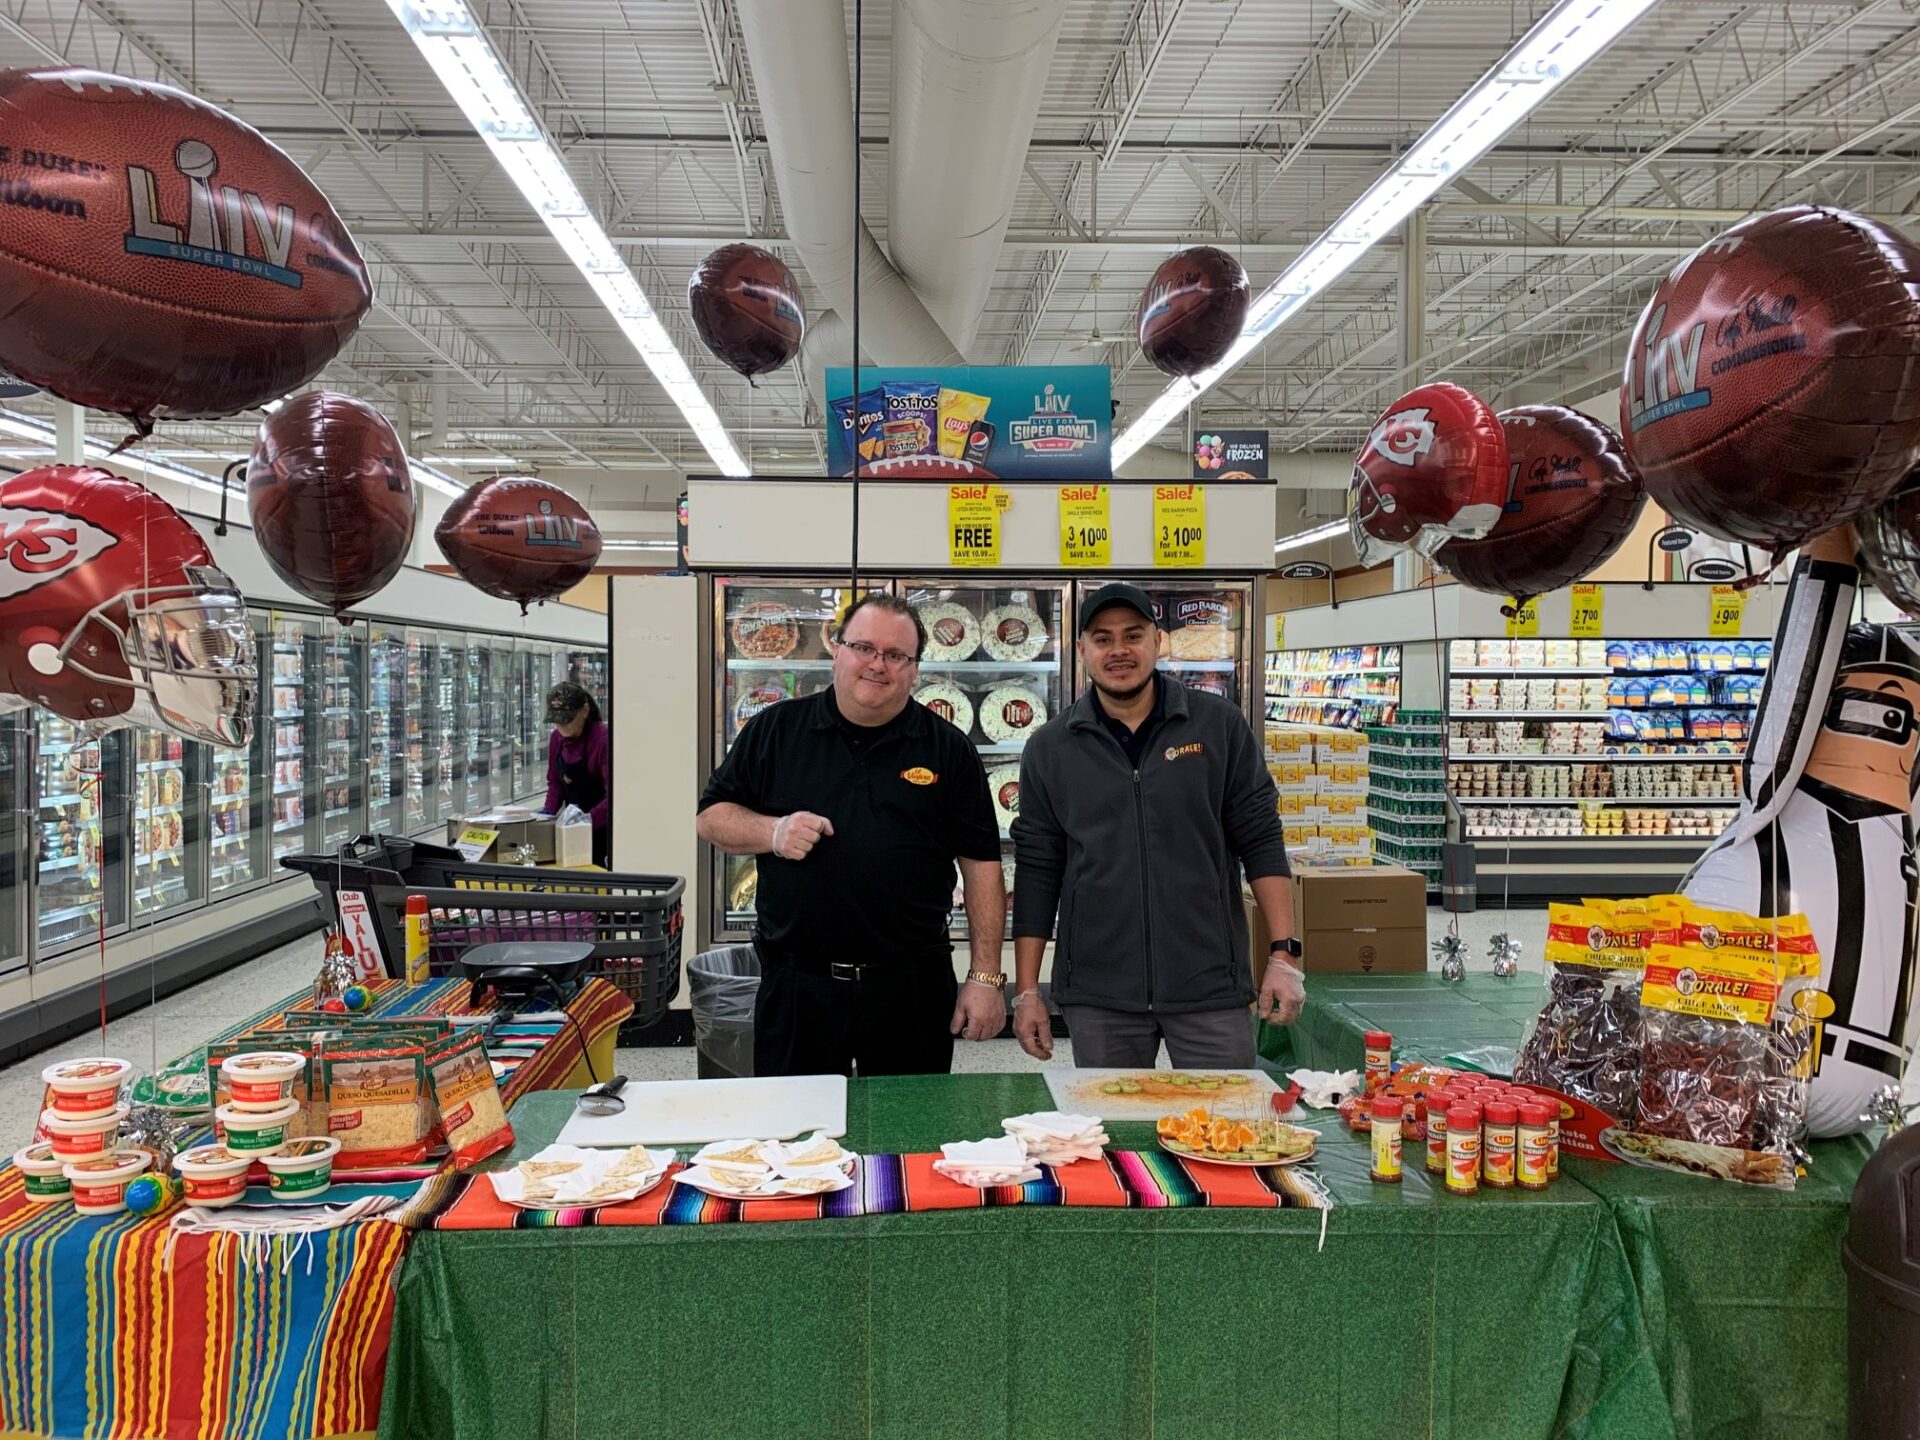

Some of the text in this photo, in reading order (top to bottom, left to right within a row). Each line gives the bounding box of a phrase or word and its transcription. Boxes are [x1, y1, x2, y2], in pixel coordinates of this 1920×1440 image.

[169, 244, 272, 277] SUPER BOWL
[897, 410, 926, 420] SCOOPS!
[1014, 424, 1092, 441] SUPER BOWL
[1226, 449, 1264, 461] FROZEN
[951, 483, 989, 500] Sale!
[1061, 483, 1099, 501] Sale!
[1156, 483, 1194, 501] Sale!
[954, 528, 993, 548] FREE
[1068, 525, 1075, 541] 3
[1162, 525, 1169, 541] 3
[1065, 541, 1077, 549] for
[1159, 540, 1171, 549] for
[954, 550, 970, 558] SAVE
[972, 550, 988, 558] 10.99
[1163, 550, 1178, 558] SAVE
[1572, 584, 1596, 594] Sale!
[1181, 600, 1229, 614] RED BARON
[342, 893, 360, 901] Cub
[337, 1087, 411, 1101] QUESO QUESADILLA
[444, 1085, 463, 1099] QUESO
[1560, 1129, 1587, 1140] aste
[1559, 1137, 1596, 1151] ition
